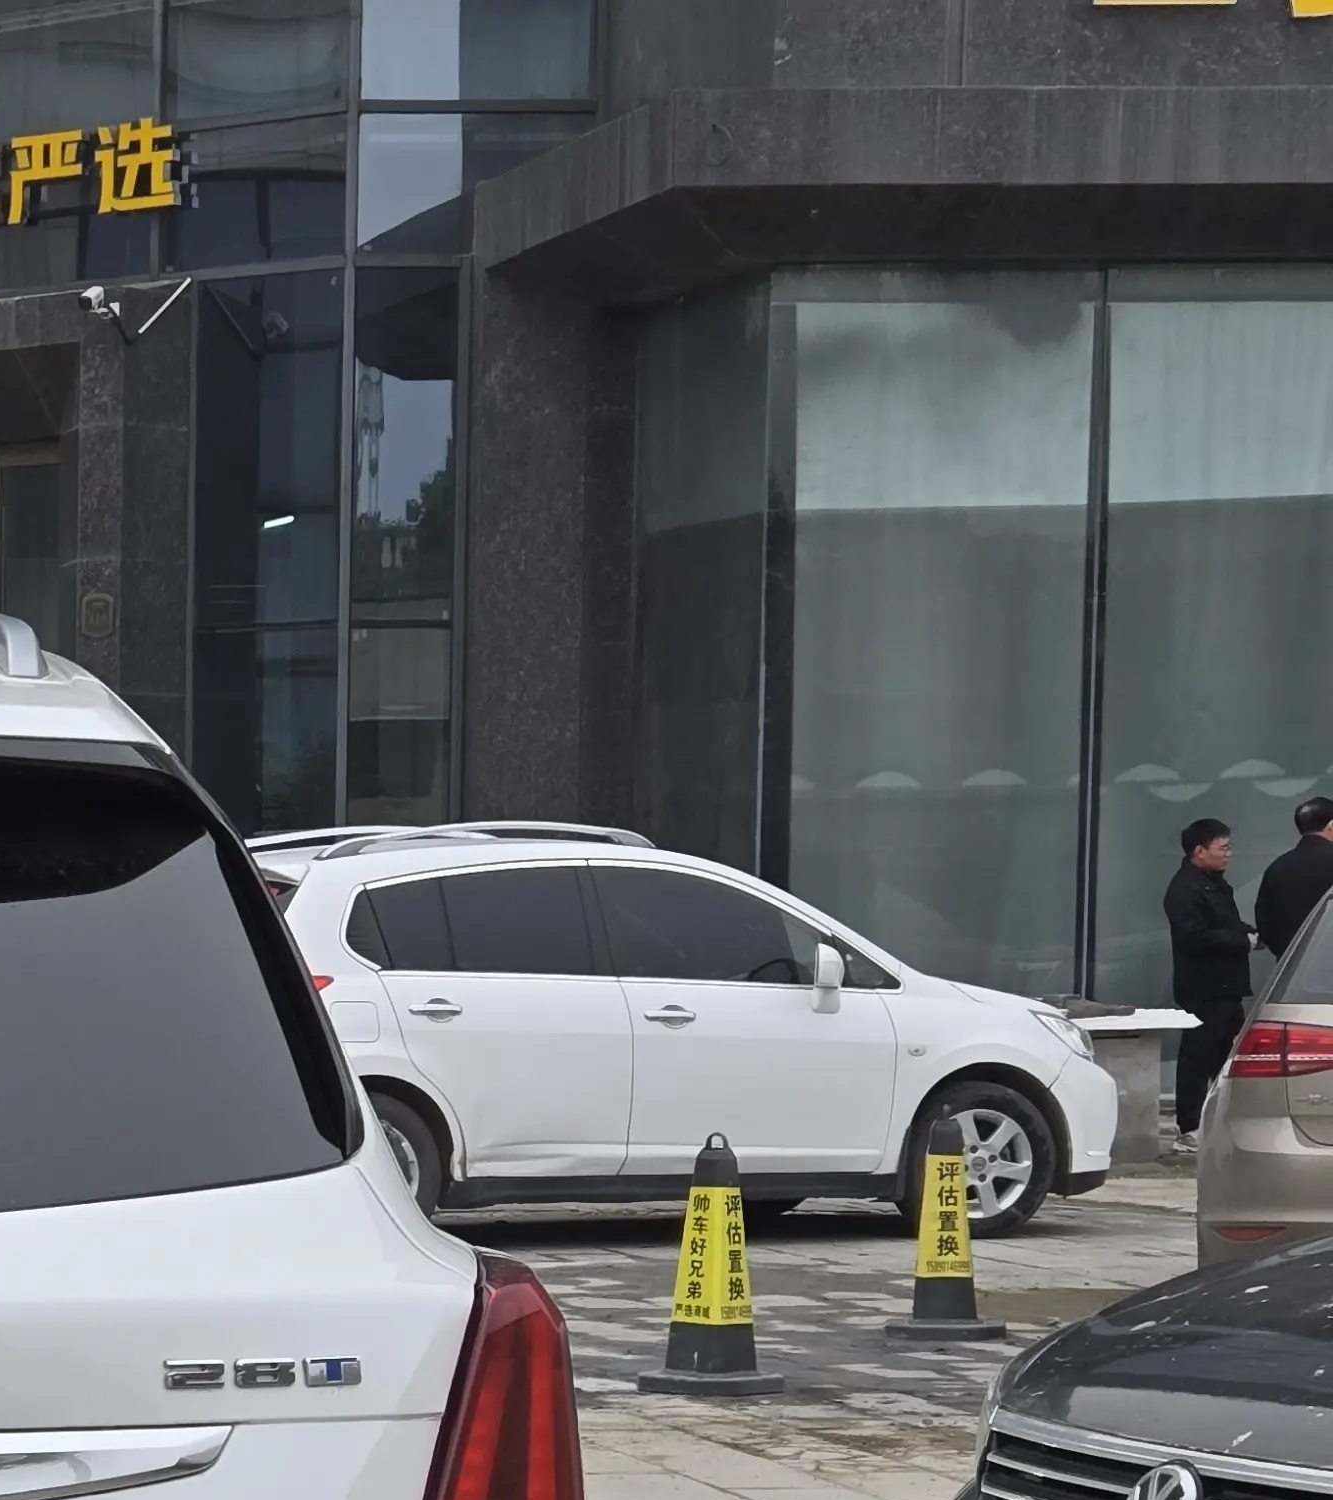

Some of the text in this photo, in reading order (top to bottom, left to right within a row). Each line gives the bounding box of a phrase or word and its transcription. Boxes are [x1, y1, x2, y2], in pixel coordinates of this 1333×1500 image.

[685, 1193, 711, 1300] 帅车好兄弟
[724, 1194, 745, 1301] 评估置换
[937, 1161, 962, 1257] 评估置换
[162, 1354, 362, 1390] 28T
